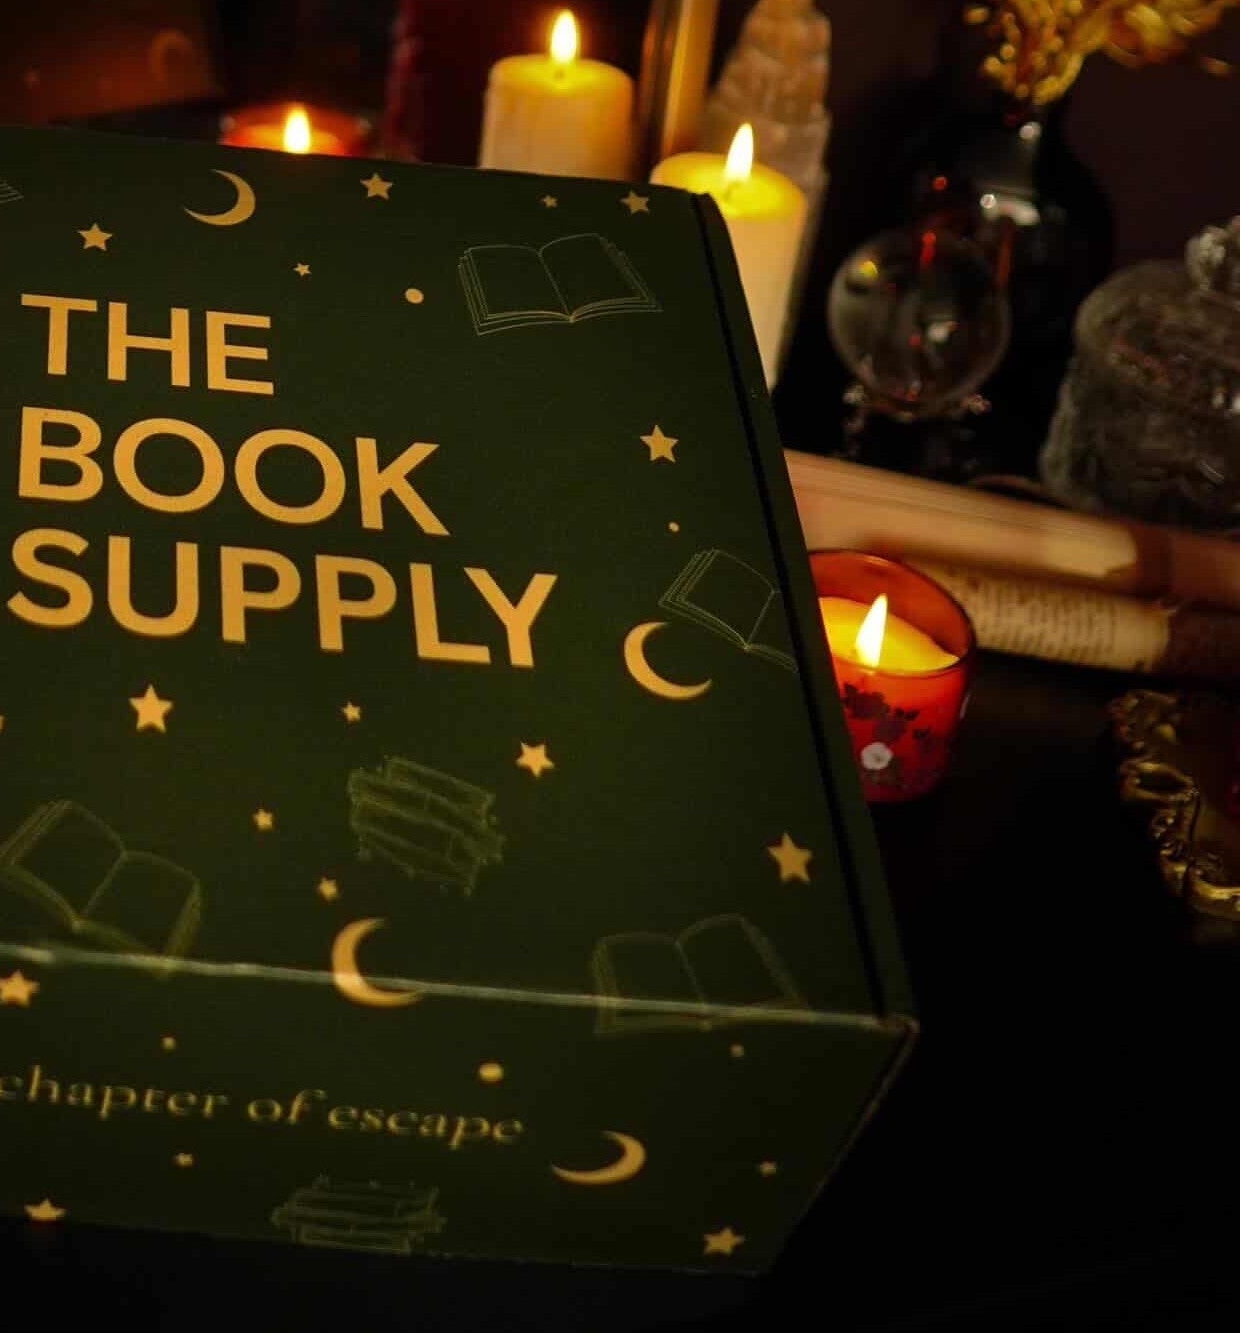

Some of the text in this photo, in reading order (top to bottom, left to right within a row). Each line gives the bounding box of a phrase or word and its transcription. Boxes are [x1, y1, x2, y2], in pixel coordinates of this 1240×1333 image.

[20, 293, 275, 396] THE
[18, 406, 450, 536] BOOK
[7, 528, 558, 668] SUPPLY
[246, 1087, 327, 1126] of
[327, 1105, 525, 1150] escape
